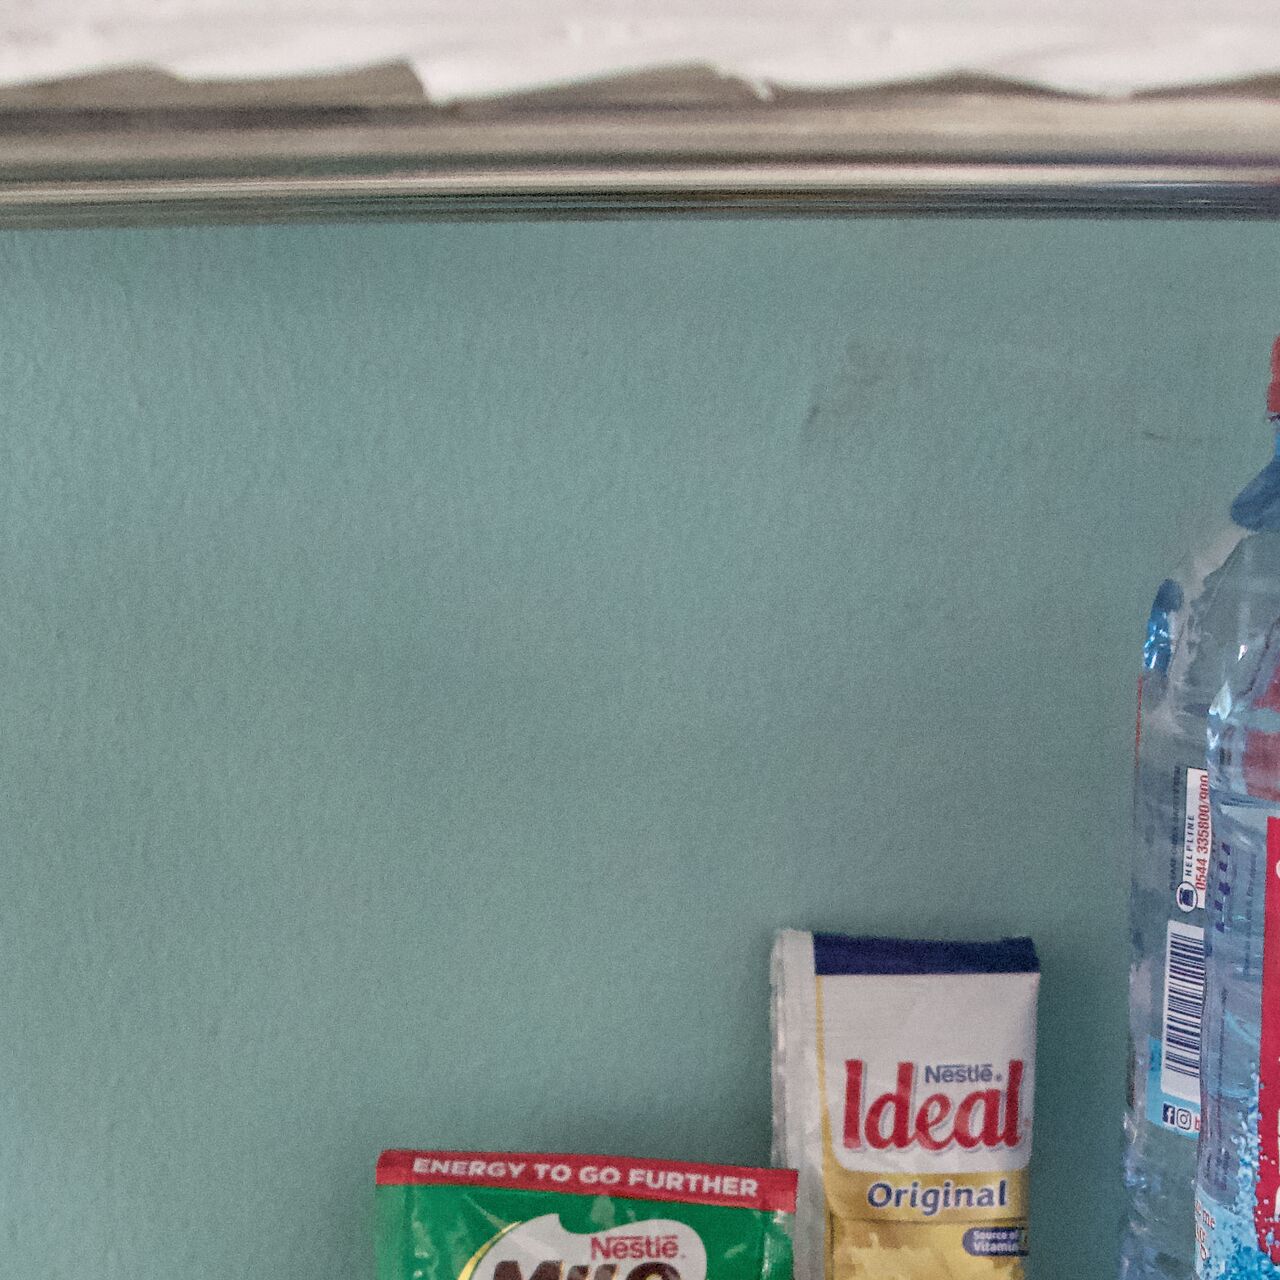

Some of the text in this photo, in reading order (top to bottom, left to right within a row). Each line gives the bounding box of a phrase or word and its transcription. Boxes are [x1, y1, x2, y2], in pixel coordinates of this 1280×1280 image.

[1185, 814, 1195, 877] HELPLINE
[842, 1058, 1024, 1151] Ideal
[413, 1158, 760, 1198] ENERGY TO GO FURTHER
[867, 1179, 1008, 1217] Original
